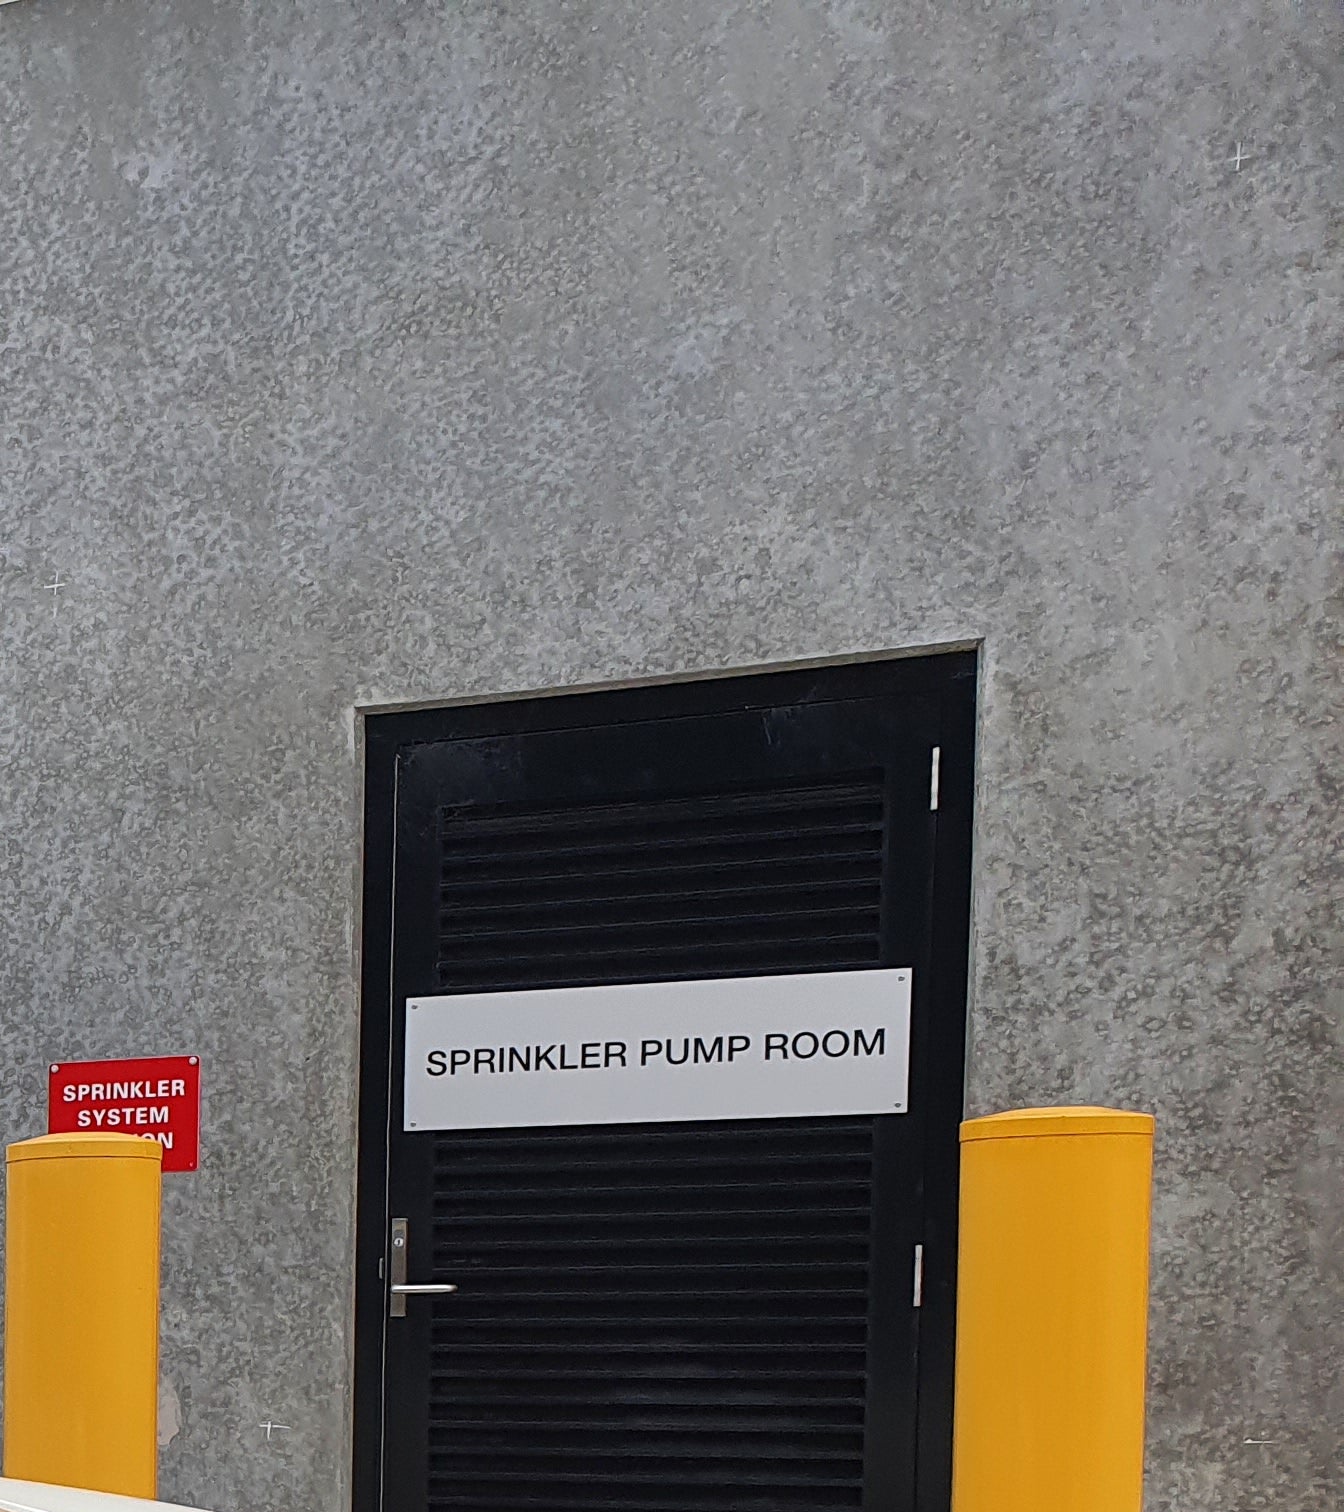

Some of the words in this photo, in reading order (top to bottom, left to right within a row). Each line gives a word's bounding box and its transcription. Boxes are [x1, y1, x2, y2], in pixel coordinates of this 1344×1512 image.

[426, 1041, 627, 1076] SPRINKLER
[640, 1035, 751, 1067] PUMP
[764, 1028, 886, 1061] ROOM
[62, 1079, 186, 1102] SPRINKLER
[77, 1106, 169, 1127] SYSTEM
